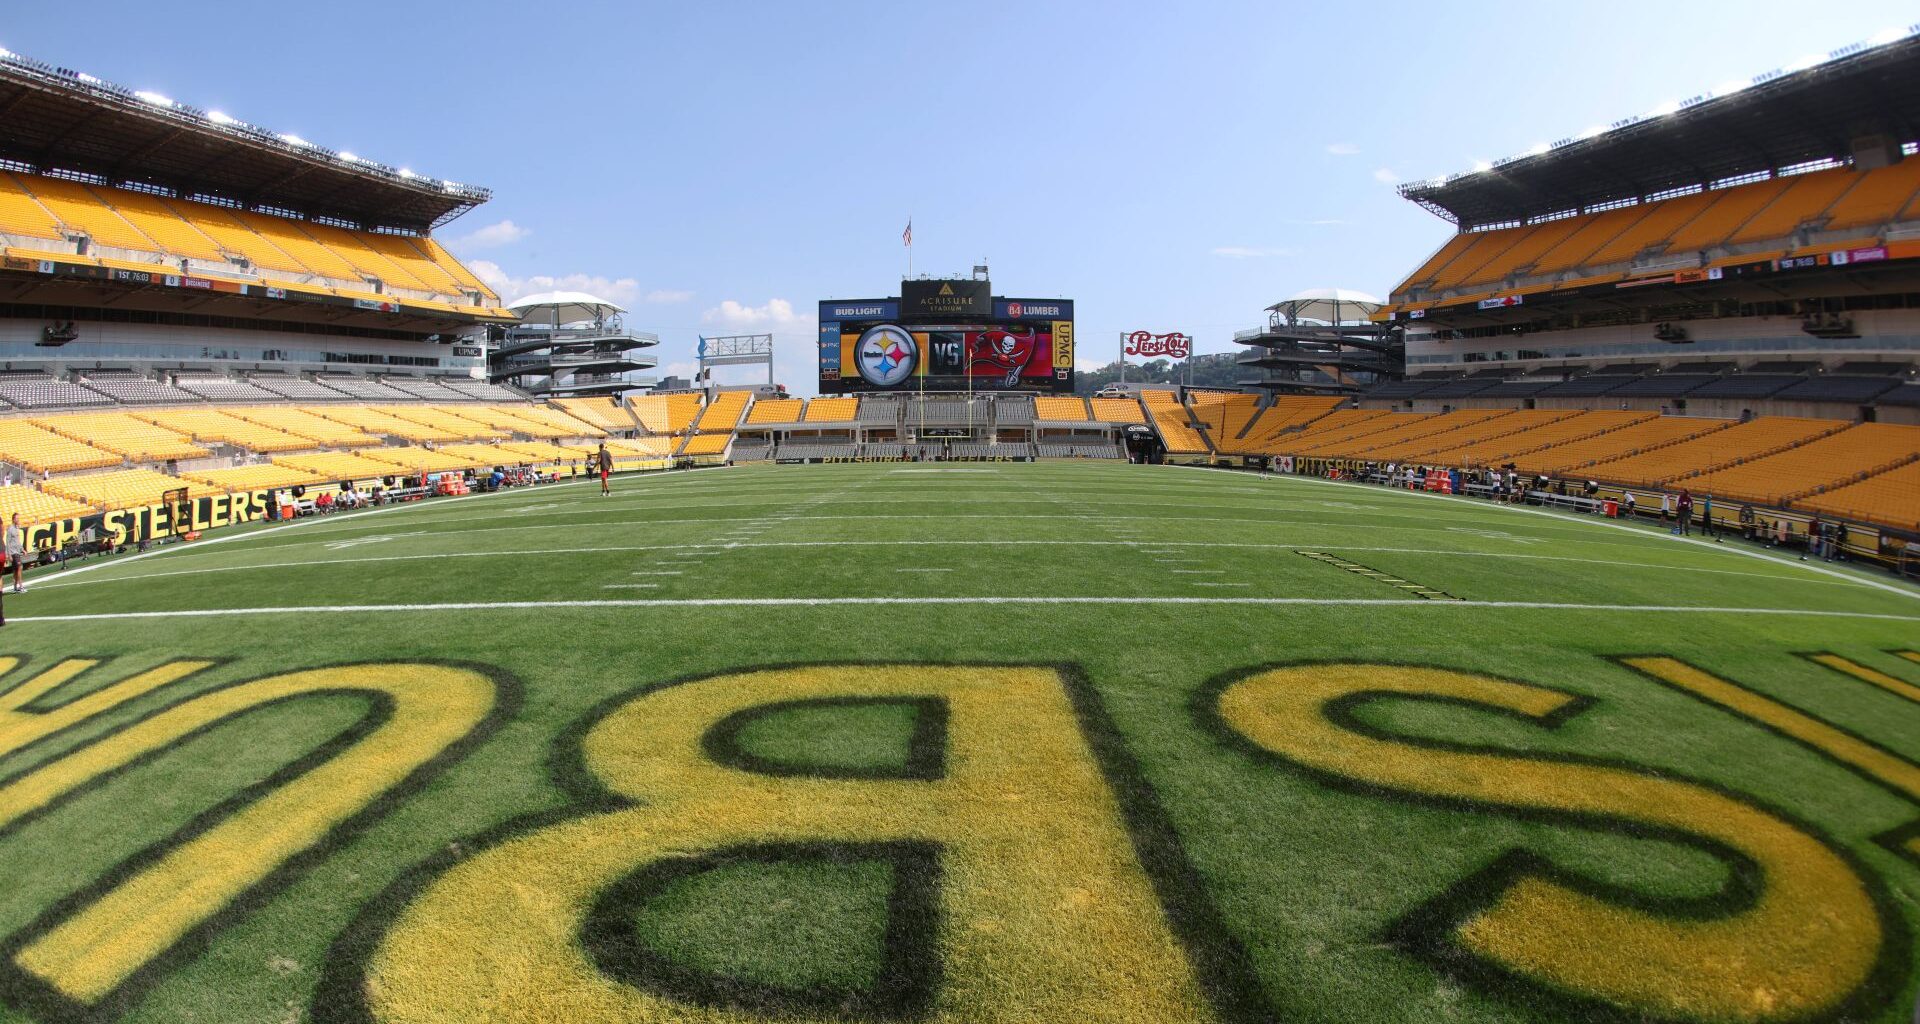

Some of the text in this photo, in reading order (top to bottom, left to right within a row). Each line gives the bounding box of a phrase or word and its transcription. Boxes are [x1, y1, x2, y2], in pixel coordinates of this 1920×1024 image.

[118, 271, 149, 282] 1ST 76:03
[920, 297, 973, 305] ACRISURE
[835, 307, 882, 316] BUD LIGHT
[1009, 306, 1060, 315] 84 LUMBER
[1058, 324, 1070, 365] UPMC
[934, 342, 959, 366] VS
[104, 489, 269, 545] STEELERS
